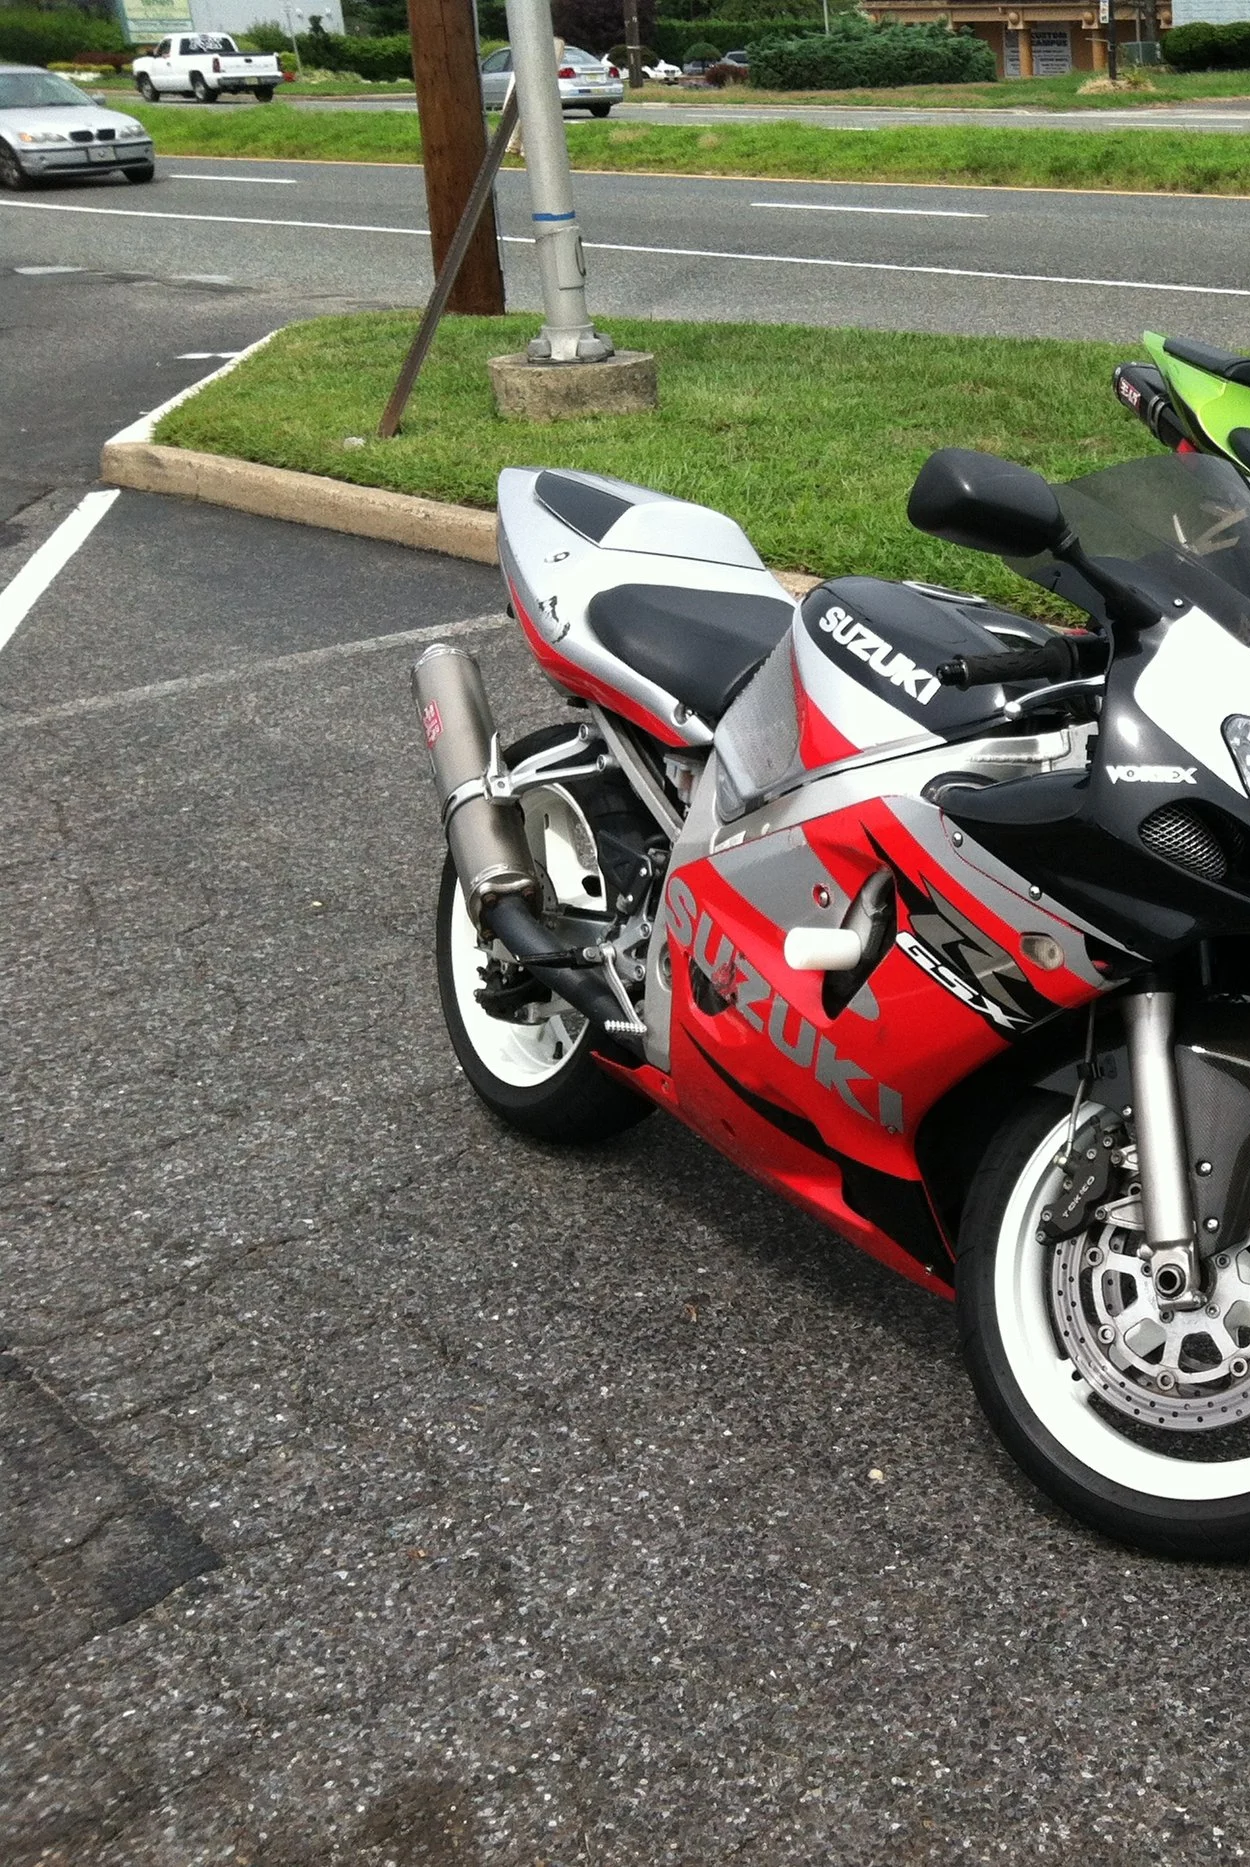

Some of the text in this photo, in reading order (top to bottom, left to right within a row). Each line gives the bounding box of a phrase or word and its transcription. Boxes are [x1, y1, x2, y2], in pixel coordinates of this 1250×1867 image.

[819, 606, 942, 705] SUZUKI
[665, 876, 904, 1134] SUZUKI
[1062, 1175, 1095, 1218] TOKICO
